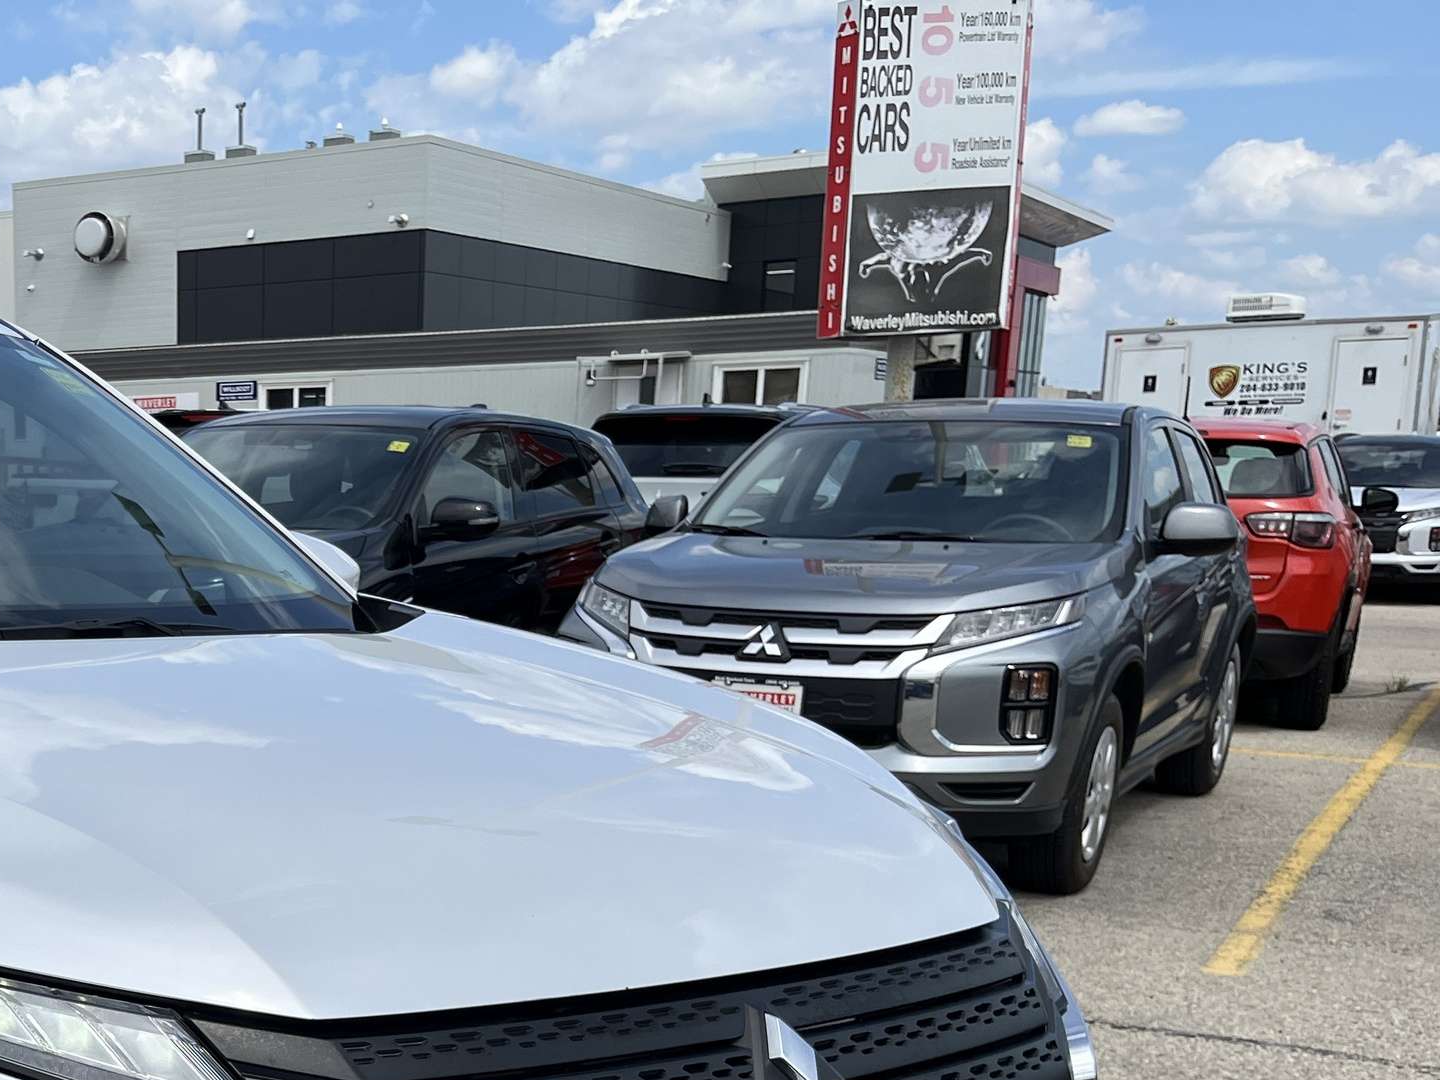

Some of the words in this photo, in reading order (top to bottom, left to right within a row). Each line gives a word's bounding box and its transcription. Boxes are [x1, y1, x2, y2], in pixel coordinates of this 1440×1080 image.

[862, 6, 918, 60] BEST
[921, 5, 955, 56] 10
[1010, 11, 1021, 26] km
[860, 64, 913, 98] BACKED
[1005, 71, 1016, 87] km
[857, 101, 910, 154] CARS
[827, 46, 852, 329] MITSUBISHI
[850, 310, 997, 331] WaverleyMitsubishi.com
[1242, 361, 1308, 375] KING'S
